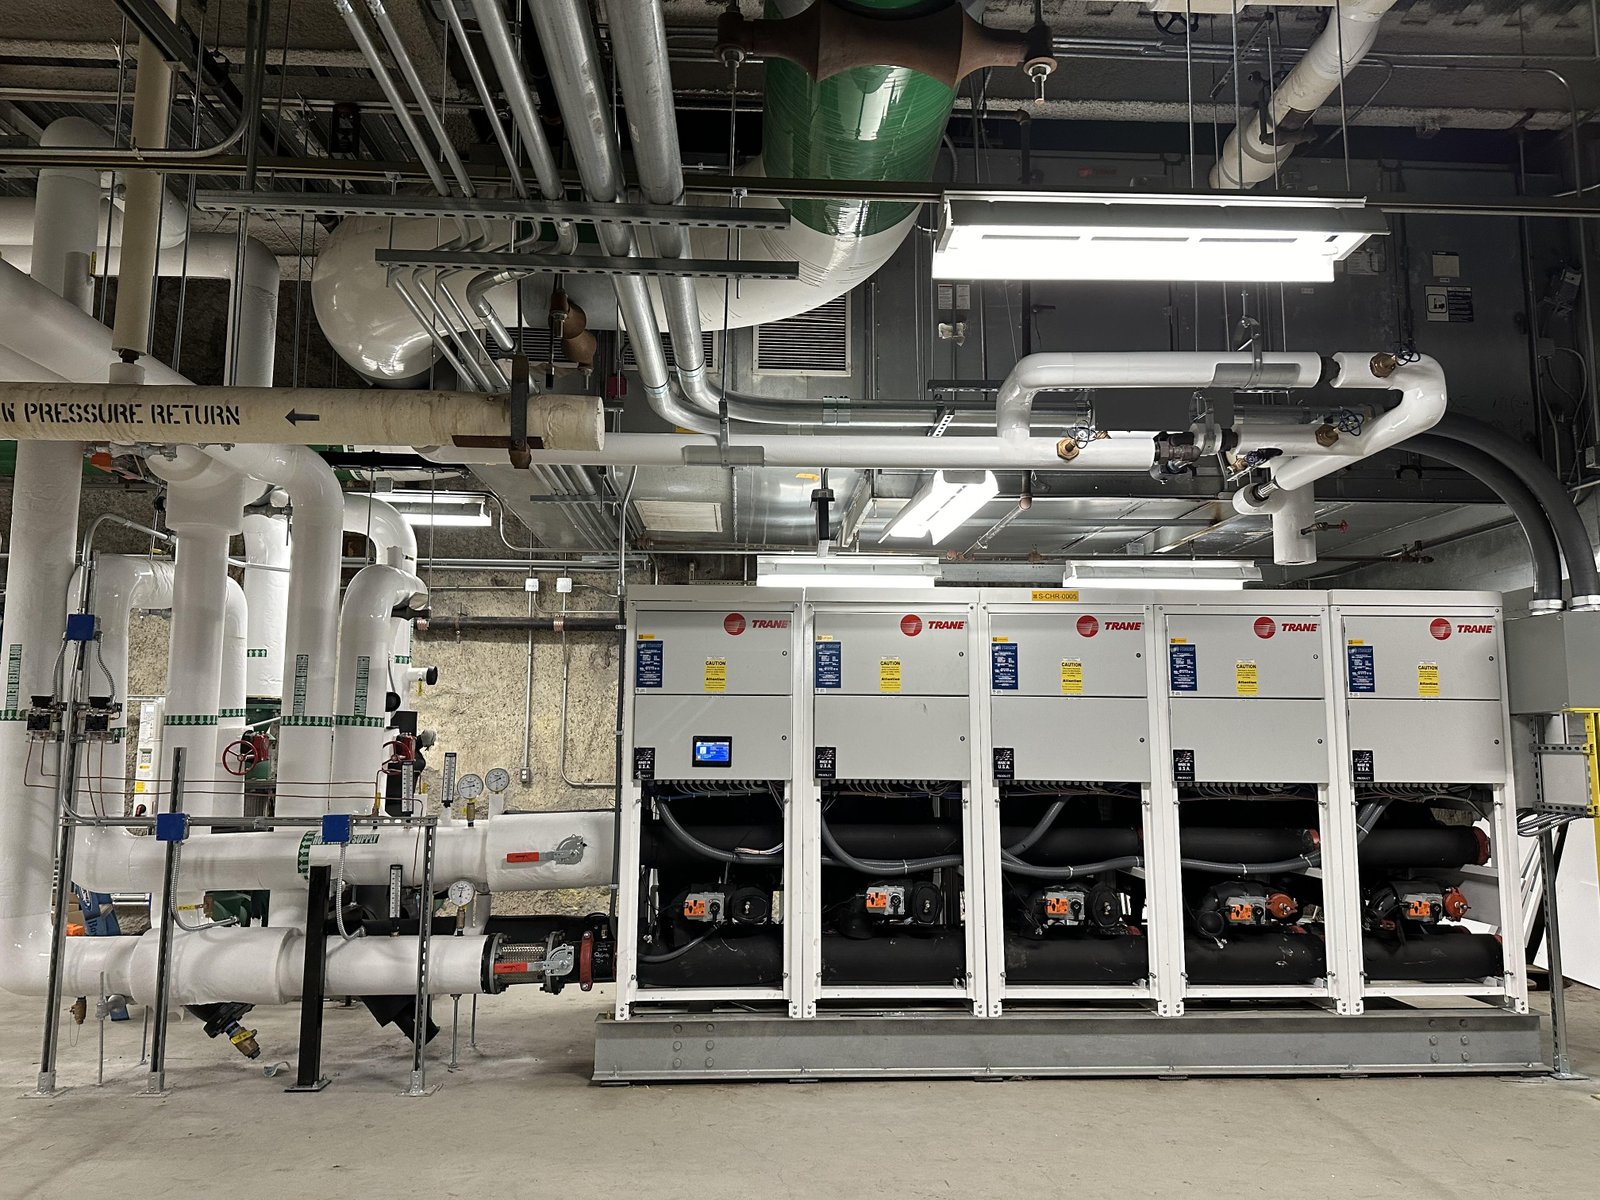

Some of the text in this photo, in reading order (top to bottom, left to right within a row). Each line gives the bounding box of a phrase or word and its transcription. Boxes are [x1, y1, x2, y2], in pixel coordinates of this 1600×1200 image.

[24, 403, 143, 424] PRESSURE
[151, 404, 240, 425] RETURN
[752, 619, 789, 629] TRANE
[928, 620, 965, 630] TRANE
[1104, 621, 1142, 631] TRANE
[1281, 623, 1318, 632] TRANE
[1457, 624, 1493, 634] TRANE
[8, 660, 20, 683] WATER
[352, 834, 378, 844] SUPPLY
